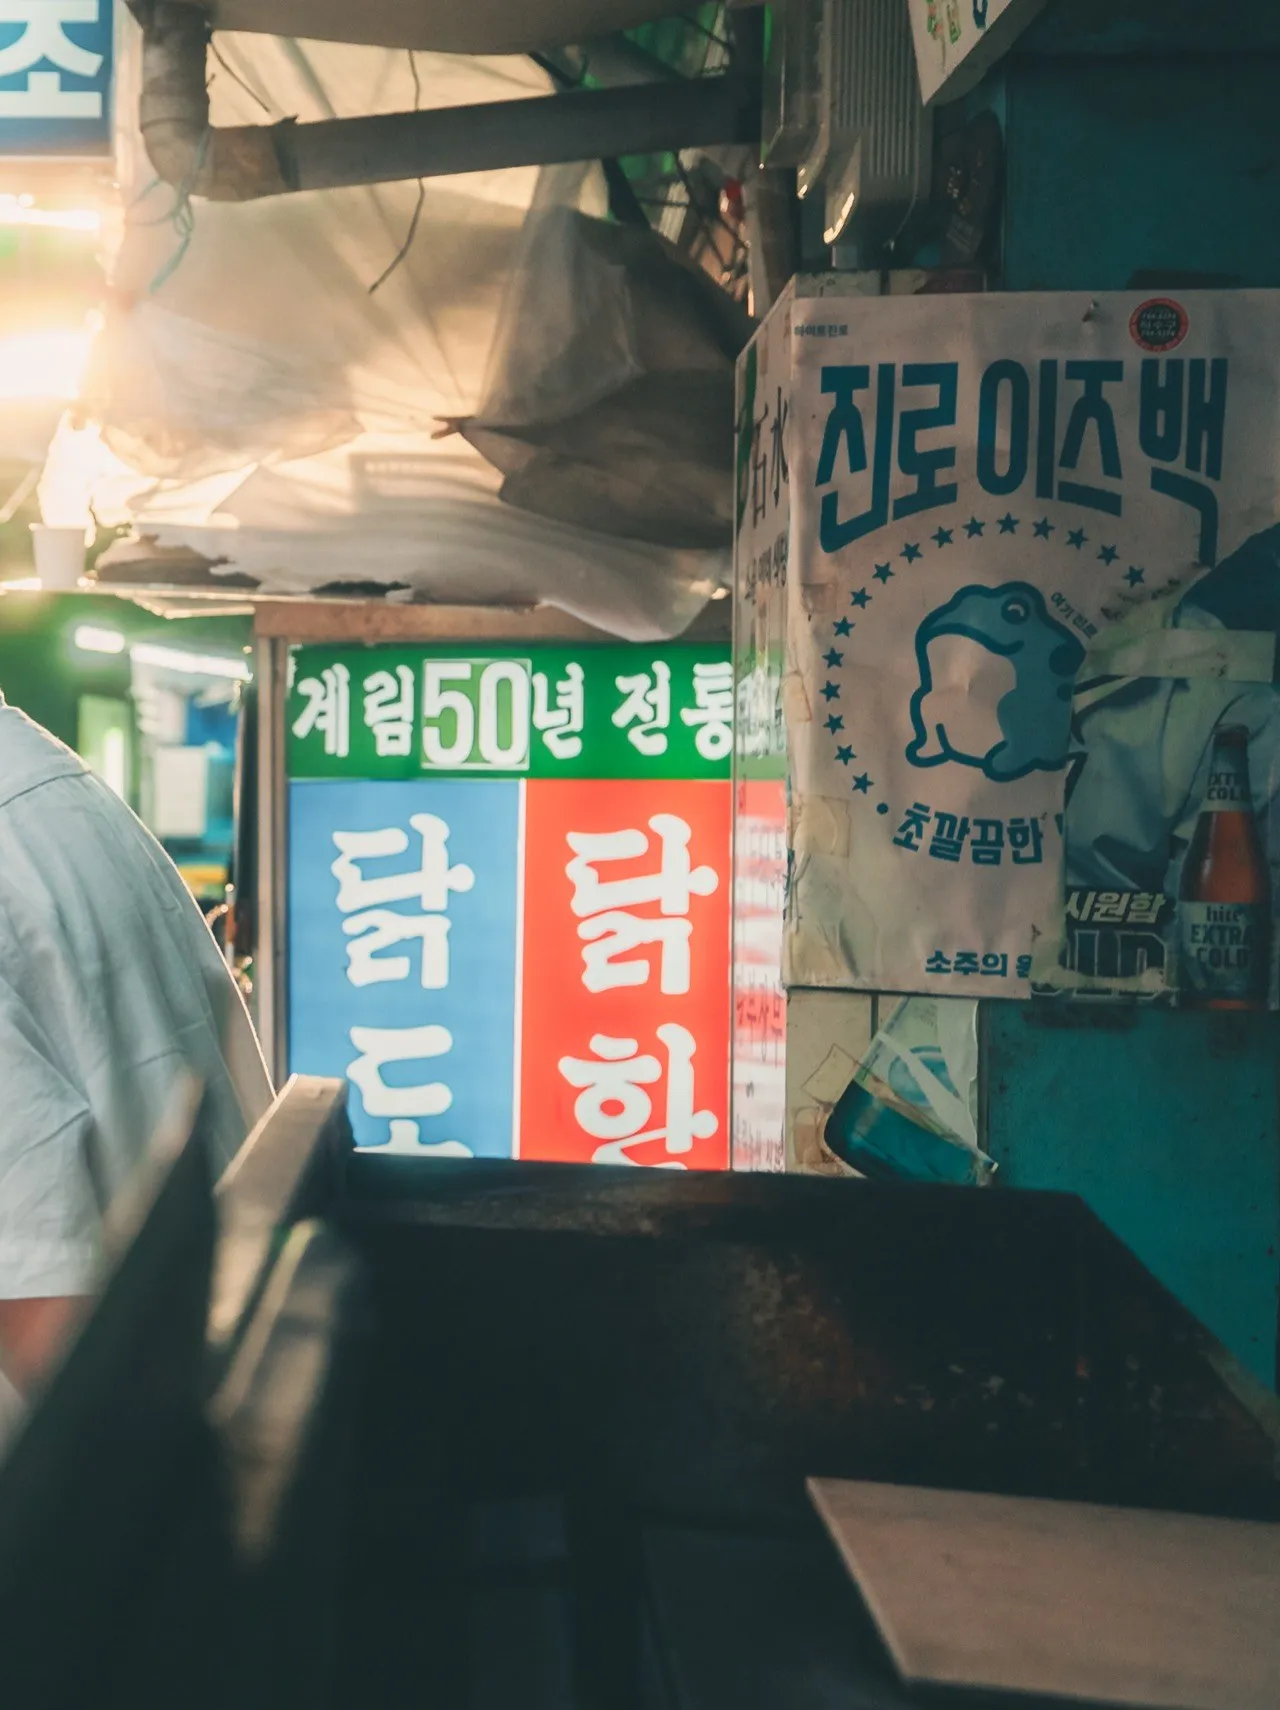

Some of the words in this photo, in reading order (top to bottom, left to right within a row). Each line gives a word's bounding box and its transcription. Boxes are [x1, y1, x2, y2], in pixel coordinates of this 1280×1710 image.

[612, 660, 735, 761] 전통
[892, 802, 1043, 865] 초깔끔한
[1066, 891, 1167, 923] 시원함
[925, 949, 1008, 978] 소주의
